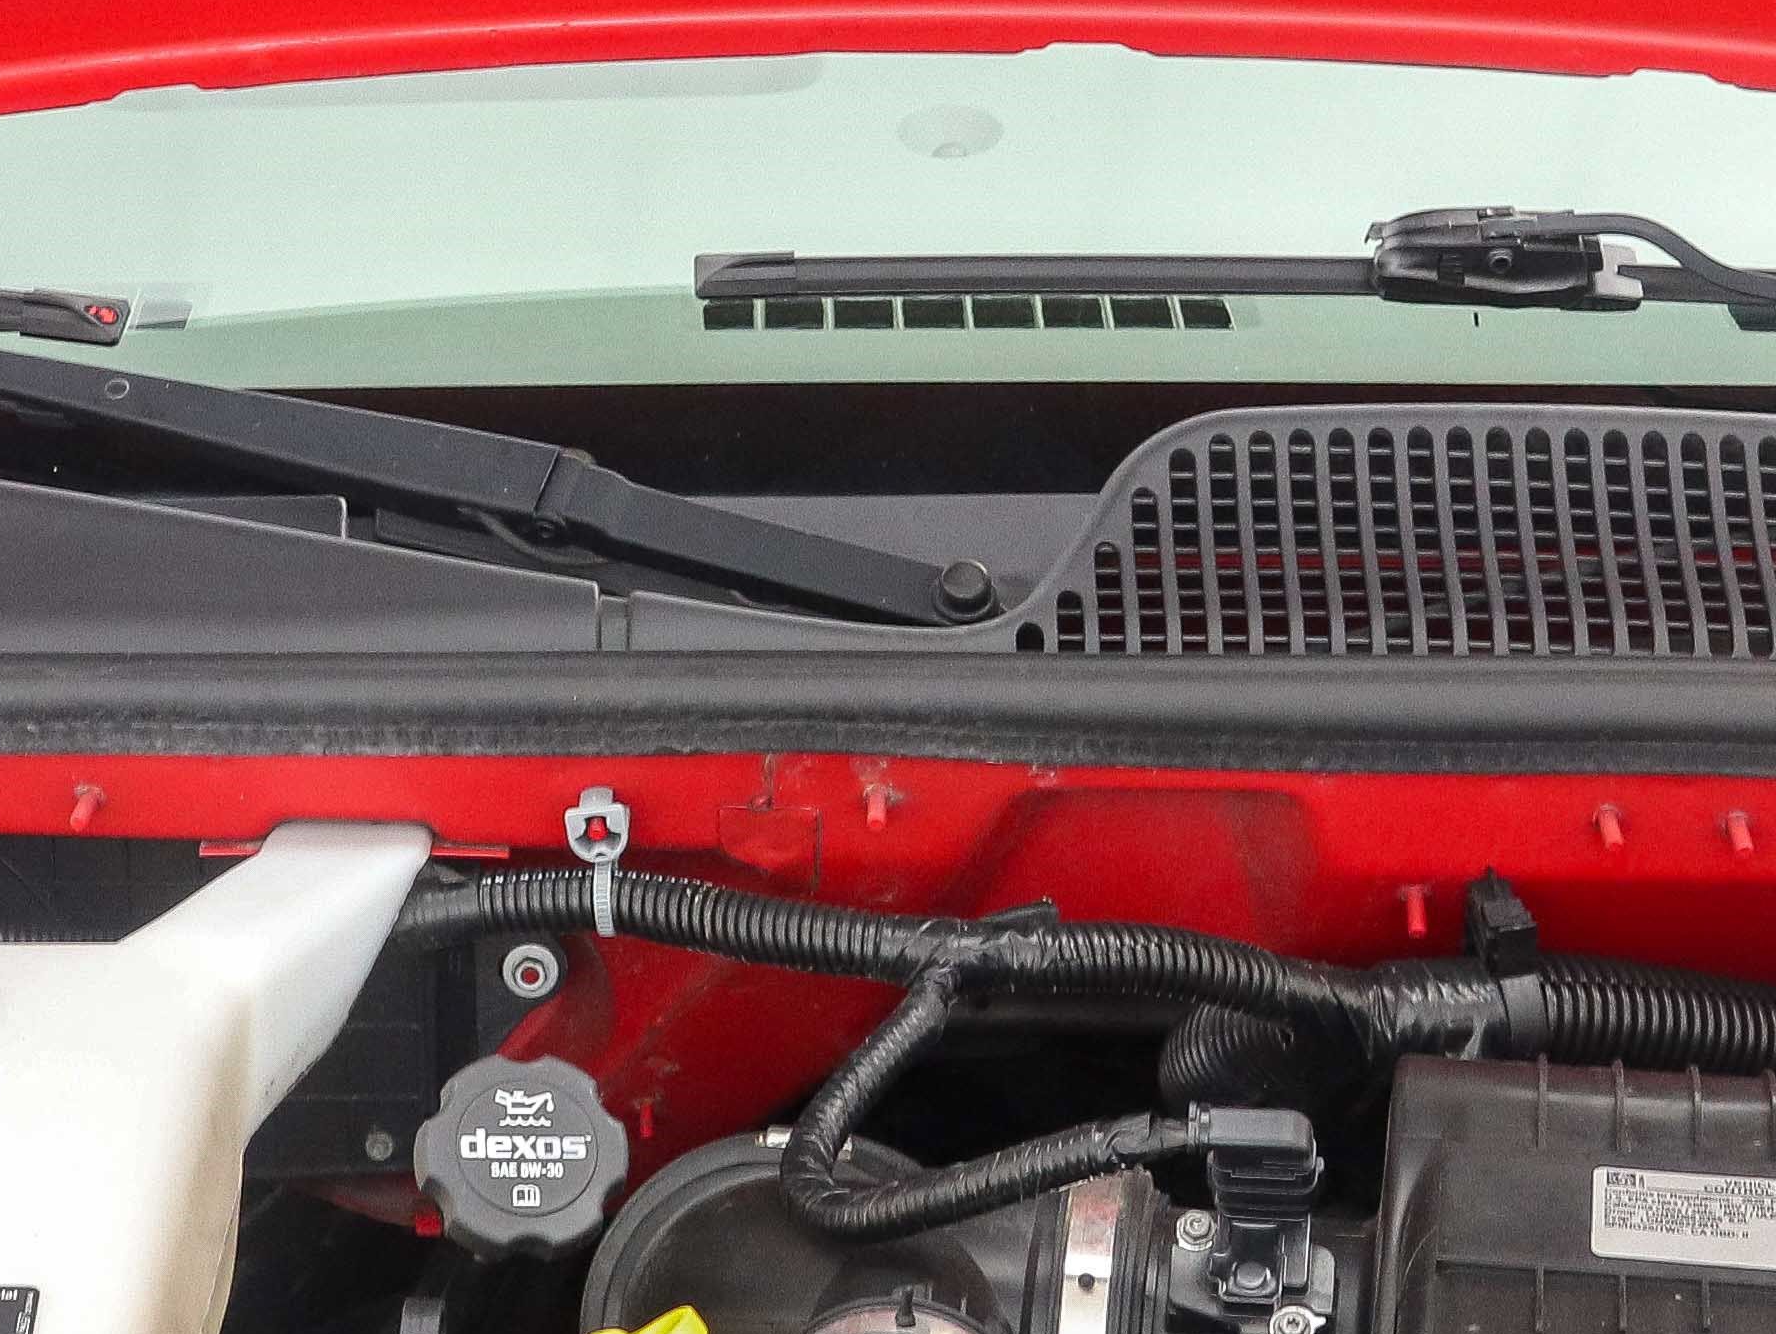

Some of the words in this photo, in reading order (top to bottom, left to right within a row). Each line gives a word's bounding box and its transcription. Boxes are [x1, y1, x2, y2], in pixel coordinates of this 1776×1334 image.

[459, 1128, 589, 1160] dexos
[490, 1162, 517, 1179] SAE
[520, 1162, 564, 1179] 5W-30
[1703, 1183, 1771, 1198] CONTROL
